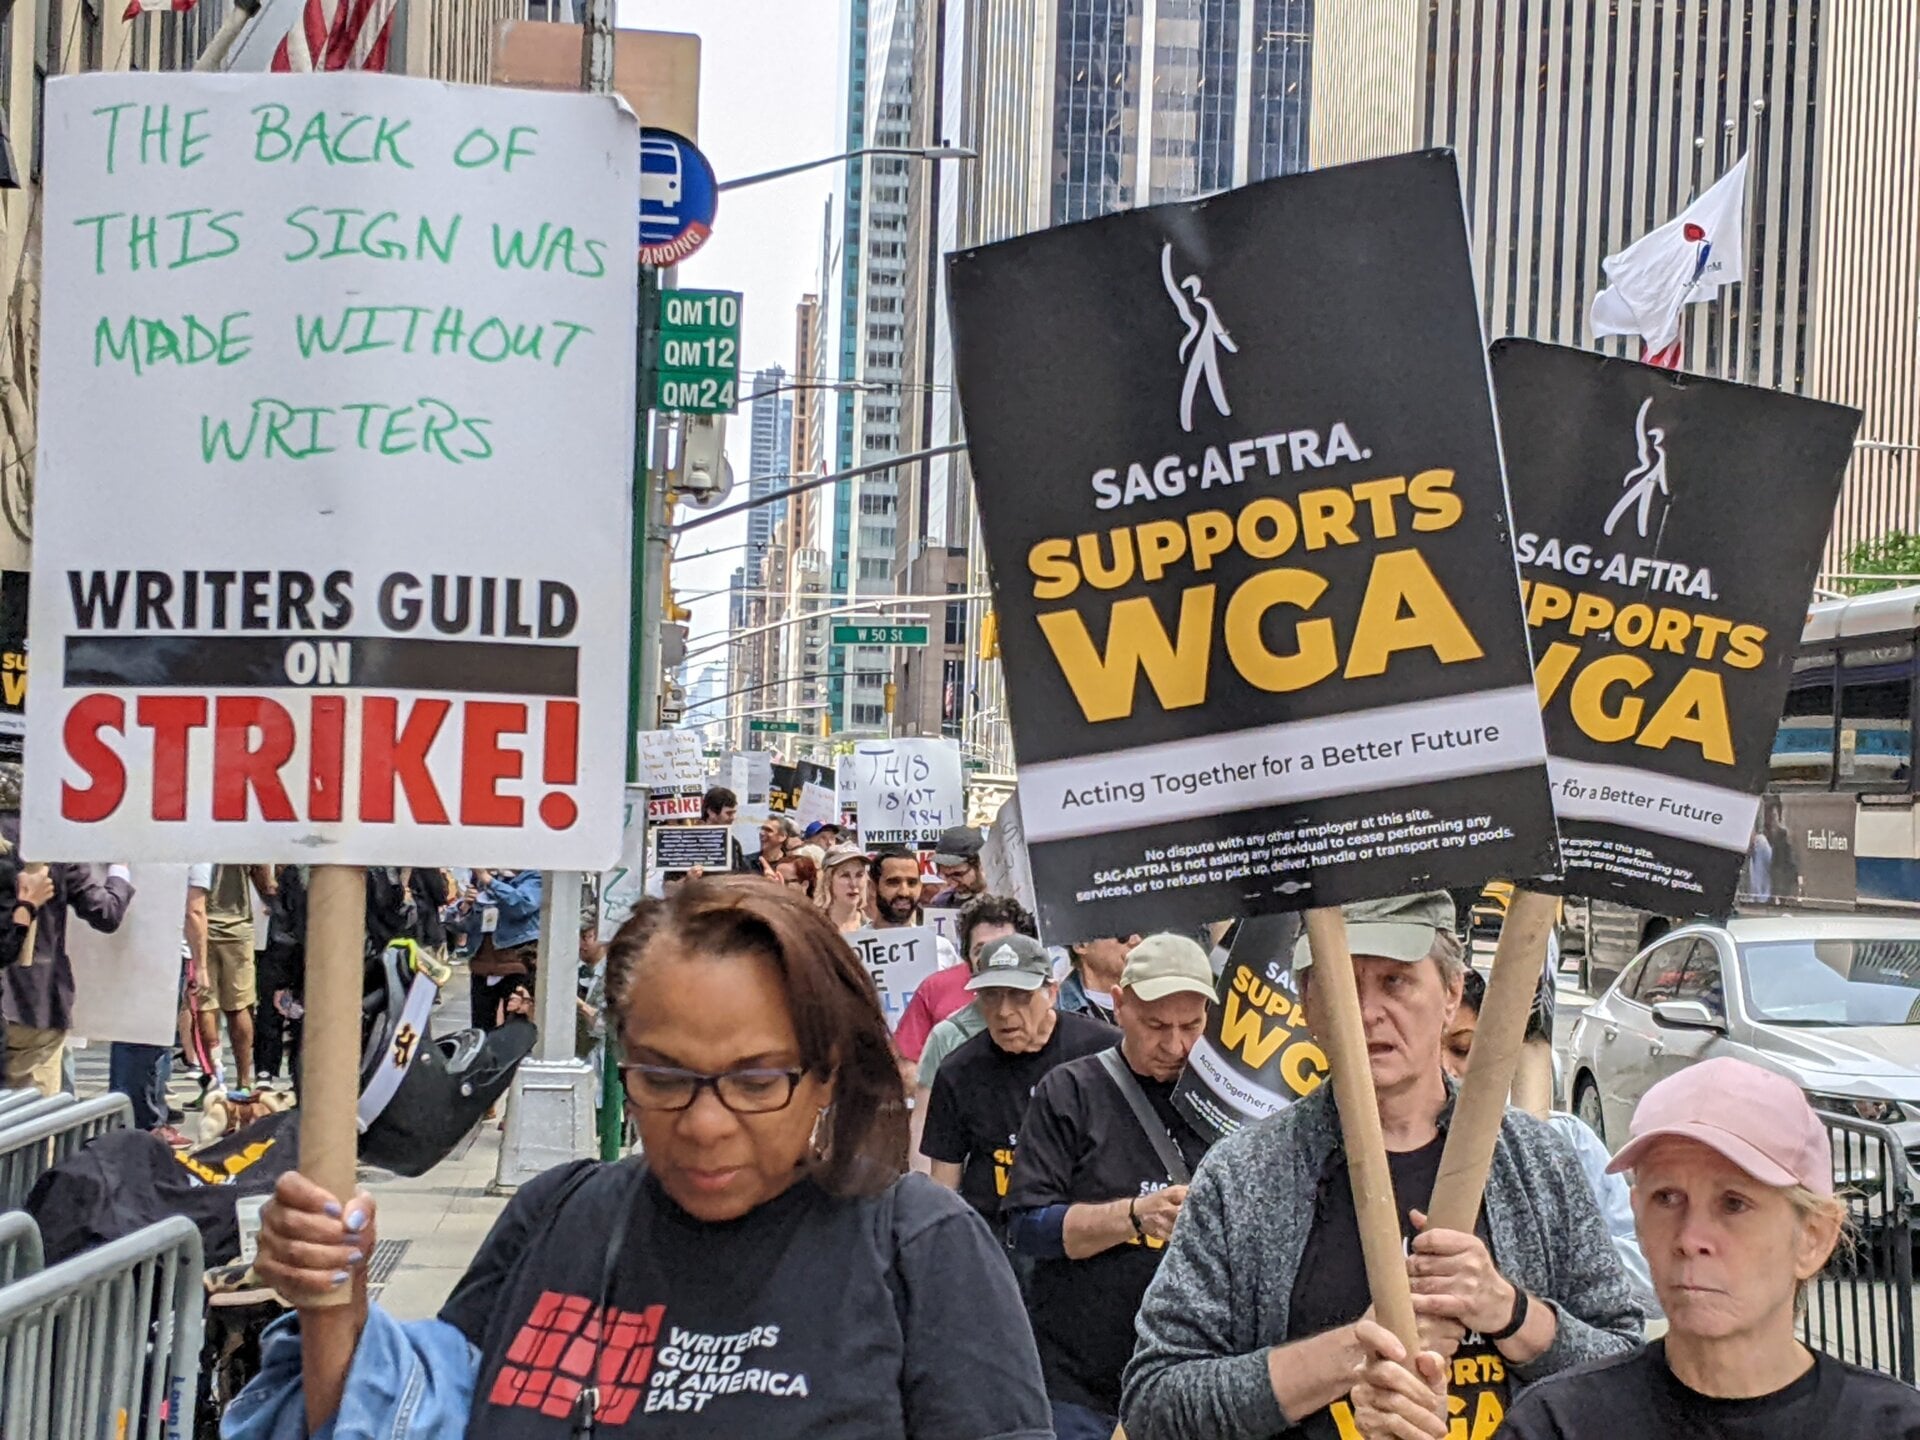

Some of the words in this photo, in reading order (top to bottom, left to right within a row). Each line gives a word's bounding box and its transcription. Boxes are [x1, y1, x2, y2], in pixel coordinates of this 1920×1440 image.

[94, 101, 210, 174] THE
[252, 103, 414, 169] BACK
[453, 126, 540, 172] OF
[74, 208, 243, 275] THIS
[285, 206, 462, 264] SIGN
[491, 221, 608, 278] WAS
[641, 229, 701, 265] ANDING
[667, 297, 737, 327] QM10
[94, 311, 251, 376] MADE
[295, 305, 596, 366] WITHOUT
[664, 338, 735, 368] QM12
[662, 378, 735, 409] QM24
[200, 398, 493, 463] WRITERS
[1028, 469, 1463, 599] SUPPORTS
[67, 570, 353, 630] WRITERS
[378, 572, 578, 637] GUILD
[1522, 580, 1768, 669] PPORTS
[858, 629, 867, 641] W
[871, 629, 886, 641] 50
[891, 629, 903, 641] St
[1036, 548, 1485, 722] WGA
[284, 641, 351, 685] ON
[1537, 641, 1736, 766] GA
[61, 693, 579, 830] STRIKE!
[859, 749, 930, 787] THIS
[1062, 781, 1145, 810] Acting
[1150, 762, 1257, 795] Together
[1262, 755, 1292, 778] for
[1300, 754, 1314, 770] a
[1321, 739, 1403, 767] Better
[1411, 725, 1500, 753] Future
[649, 798, 704, 816] STRIKE
[1562, 779, 1587, 799] for
[1589, 787, 1597, 800] a
[1599, 785, 1655, 809] Better
[1658, 797, 1724, 825] Future
[864, 829, 918, 843] WRITERS
[1093, 862, 1169, 885] SAG-AFTRA
[1171, 861, 1183, 873] is
[1184, 856, 1207, 871] not
[1209, 850, 1250, 868] asking
[1251, 847, 1270, 861] any
[1272, 838, 1328, 858] individual
[1330, 836, 1344, 849] to
[1346, 833, 1384, 846] cease
[1387, 820, 1463, 842] performing
[1466, 815, 1492, 830] any
[1145, 849, 1165, 862] No
[1167, 842, 1215, 859] dispute
[1217, 836, 1244, 850] with
[1246, 834, 1265, 847] any
[1267, 830, 1296, 844] other
[1297, 819, 1358, 839] employer
[1361, 817, 1375, 830] at
[1377, 812, 1404, 827] this
[1405, 808, 1434, 822] site.
[1807, 828, 1827, 850] Fresh
[1828, 828, 1849, 851] Linen
[1076, 883, 1132, 902] services,
[1133, 882, 1148, 893] or
[1149, 878, 1164, 891] to
[1166, 873, 1207, 889] refuse
[1209, 868, 1223, 881] to
[1225, 863, 1250, 881] pick
[1311, 850, 1357, 867] handle
[1359, 847, 1373, 860] or
[1376, 836, 1440, 856] transport
[1442, 833, 1467, 849] any
[1469, 826, 1515, 846] goods.
[1605, 862, 1649, 880] transport
[1651, 874, 1670, 886] any
[1616, 854, 1672, 875] performing
[1674, 867, 1693, 880] any
[1220, 988, 1330, 1097] WG
[1222, 1077, 1267, 1112] Together
[657, 1346, 741, 1374] GUILD
[670, 1325, 780, 1354] WRITERS
[644, 1389, 713, 1414] EAST
[651, 1369, 681, 1388] of
[679, 1368, 810, 1398] AMERICA
